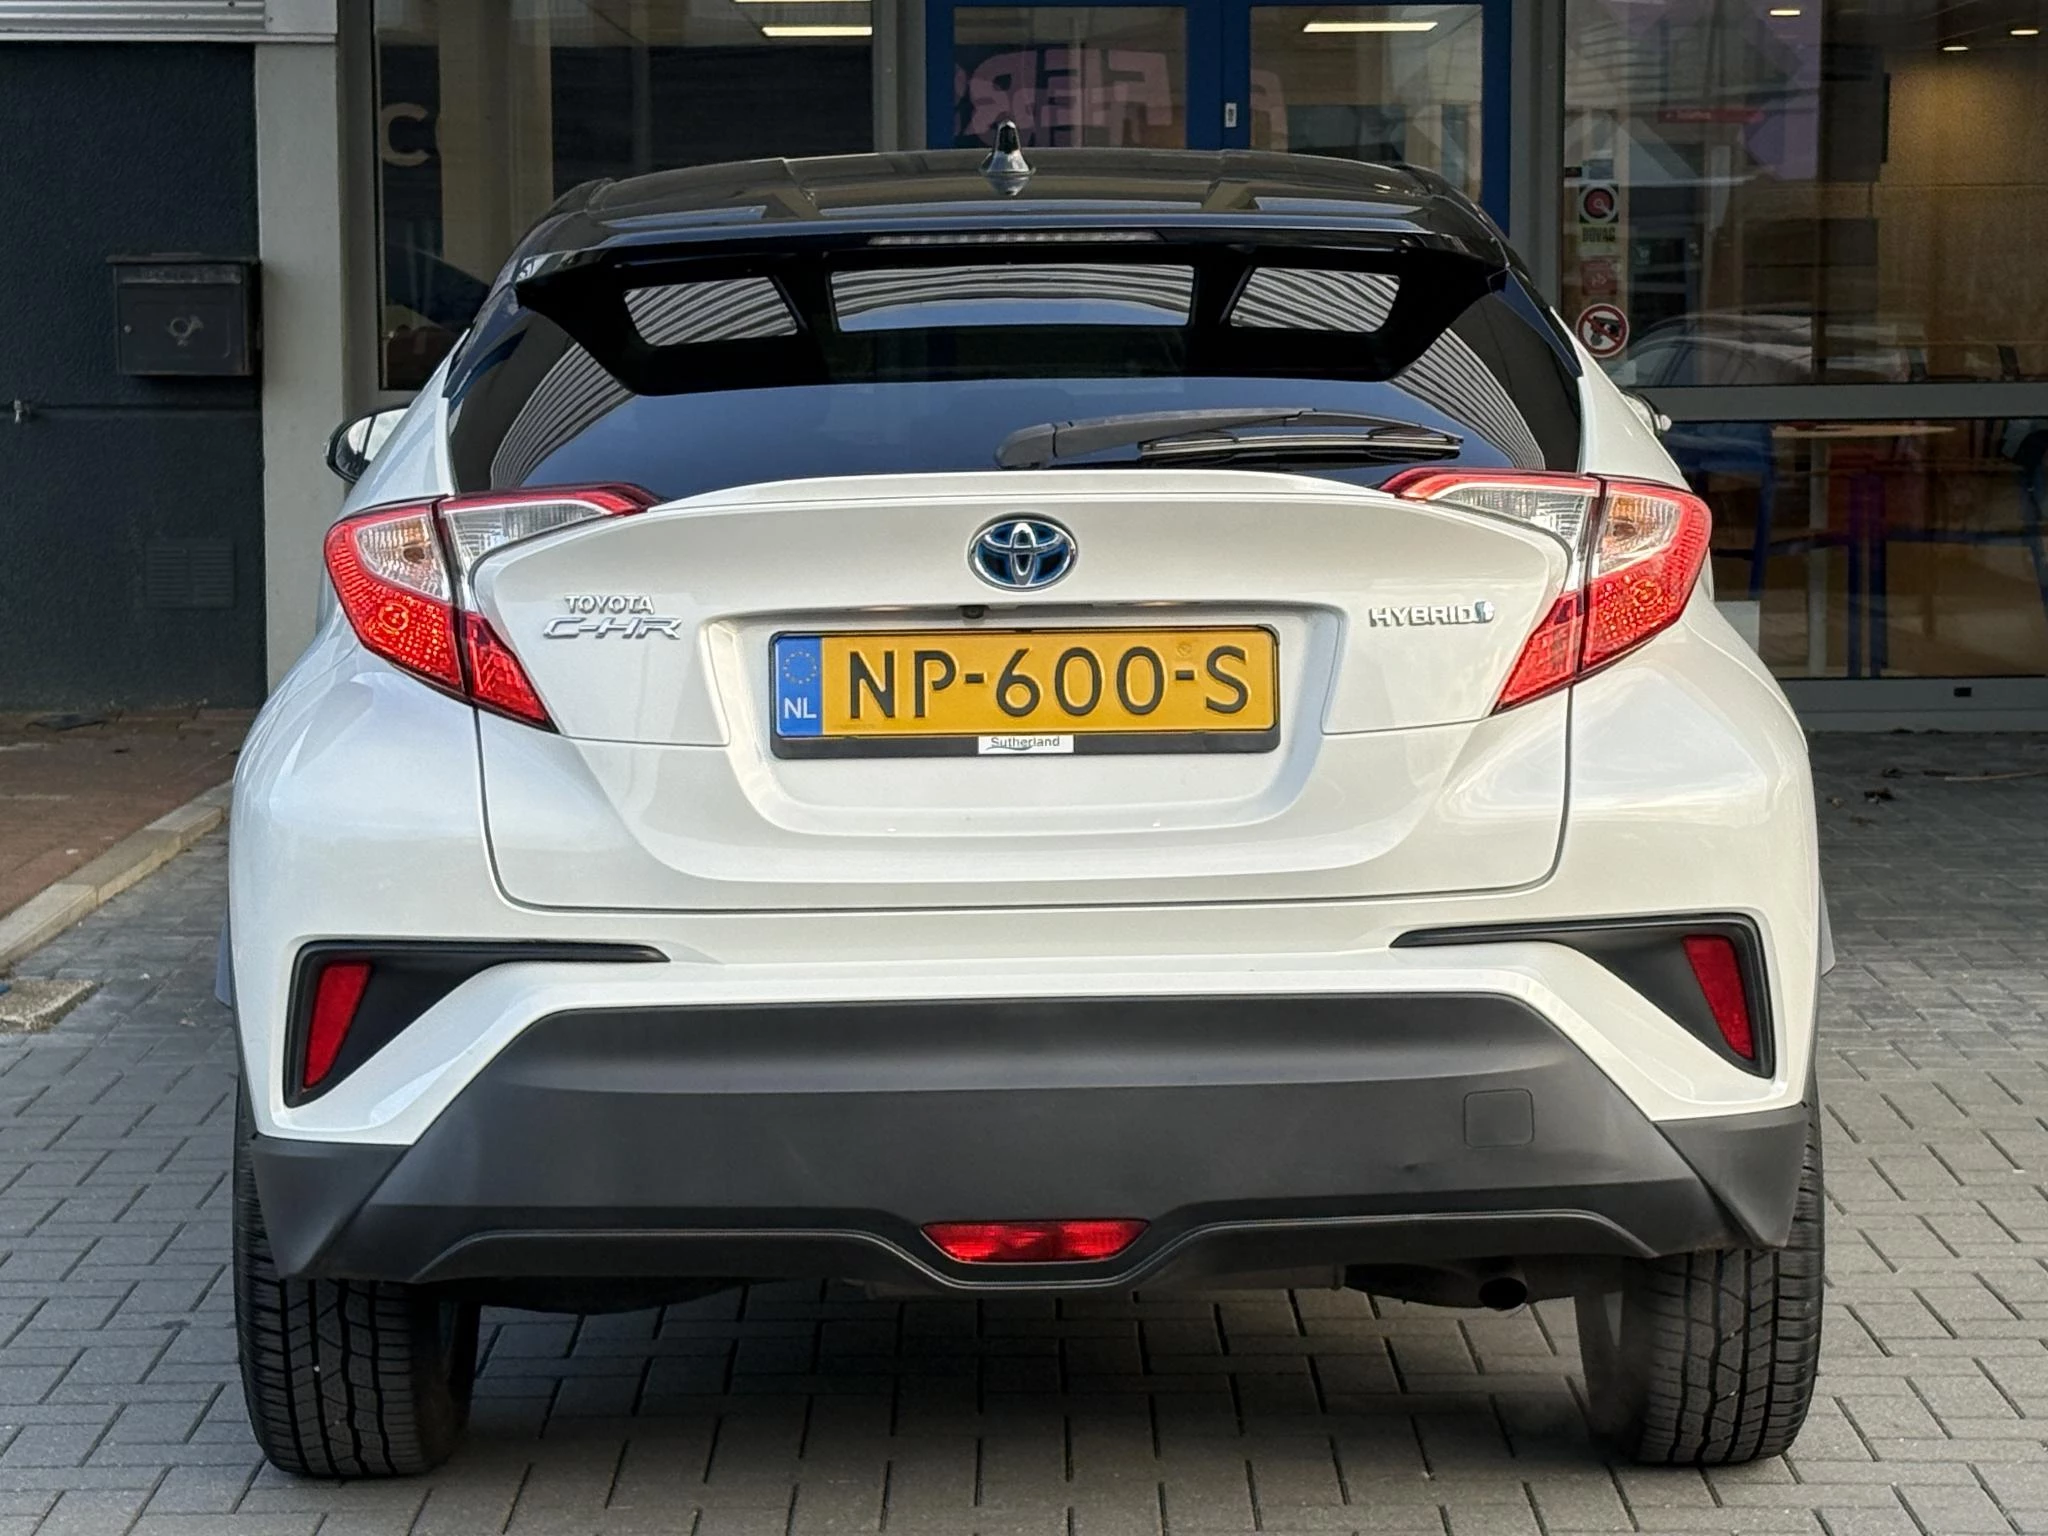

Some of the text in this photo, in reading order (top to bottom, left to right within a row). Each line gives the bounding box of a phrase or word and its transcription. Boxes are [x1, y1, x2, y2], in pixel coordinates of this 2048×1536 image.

[565, 595, 655, 614] TOYOTA
[1368, 606, 1475, 627] HYBRID
[543, 617, 682, 640] C-HR
[849, 646, 1249, 718] NP-600-S
[784, 697, 817, 720] NL
[990, 736, 1060, 749] Sutherland
